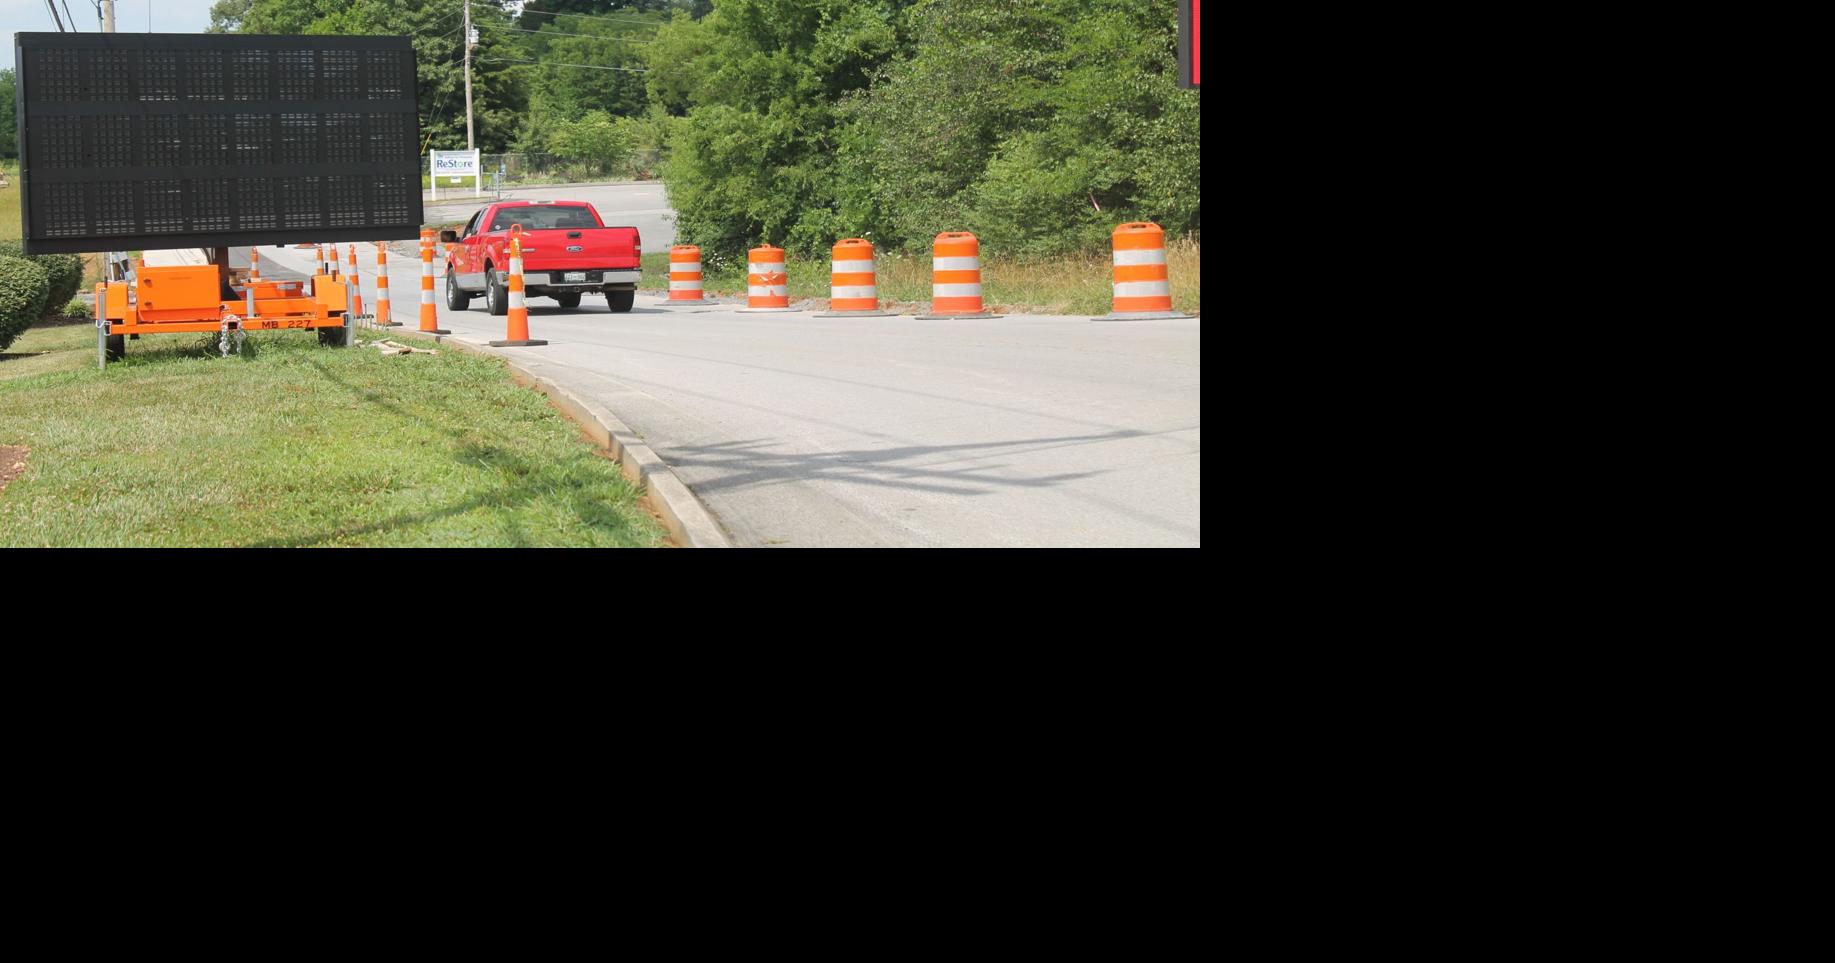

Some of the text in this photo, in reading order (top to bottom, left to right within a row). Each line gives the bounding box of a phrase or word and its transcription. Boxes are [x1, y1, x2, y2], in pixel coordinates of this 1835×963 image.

[436, 159, 473, 168] ReStore
[262, 320, 311, 329] MB 227
